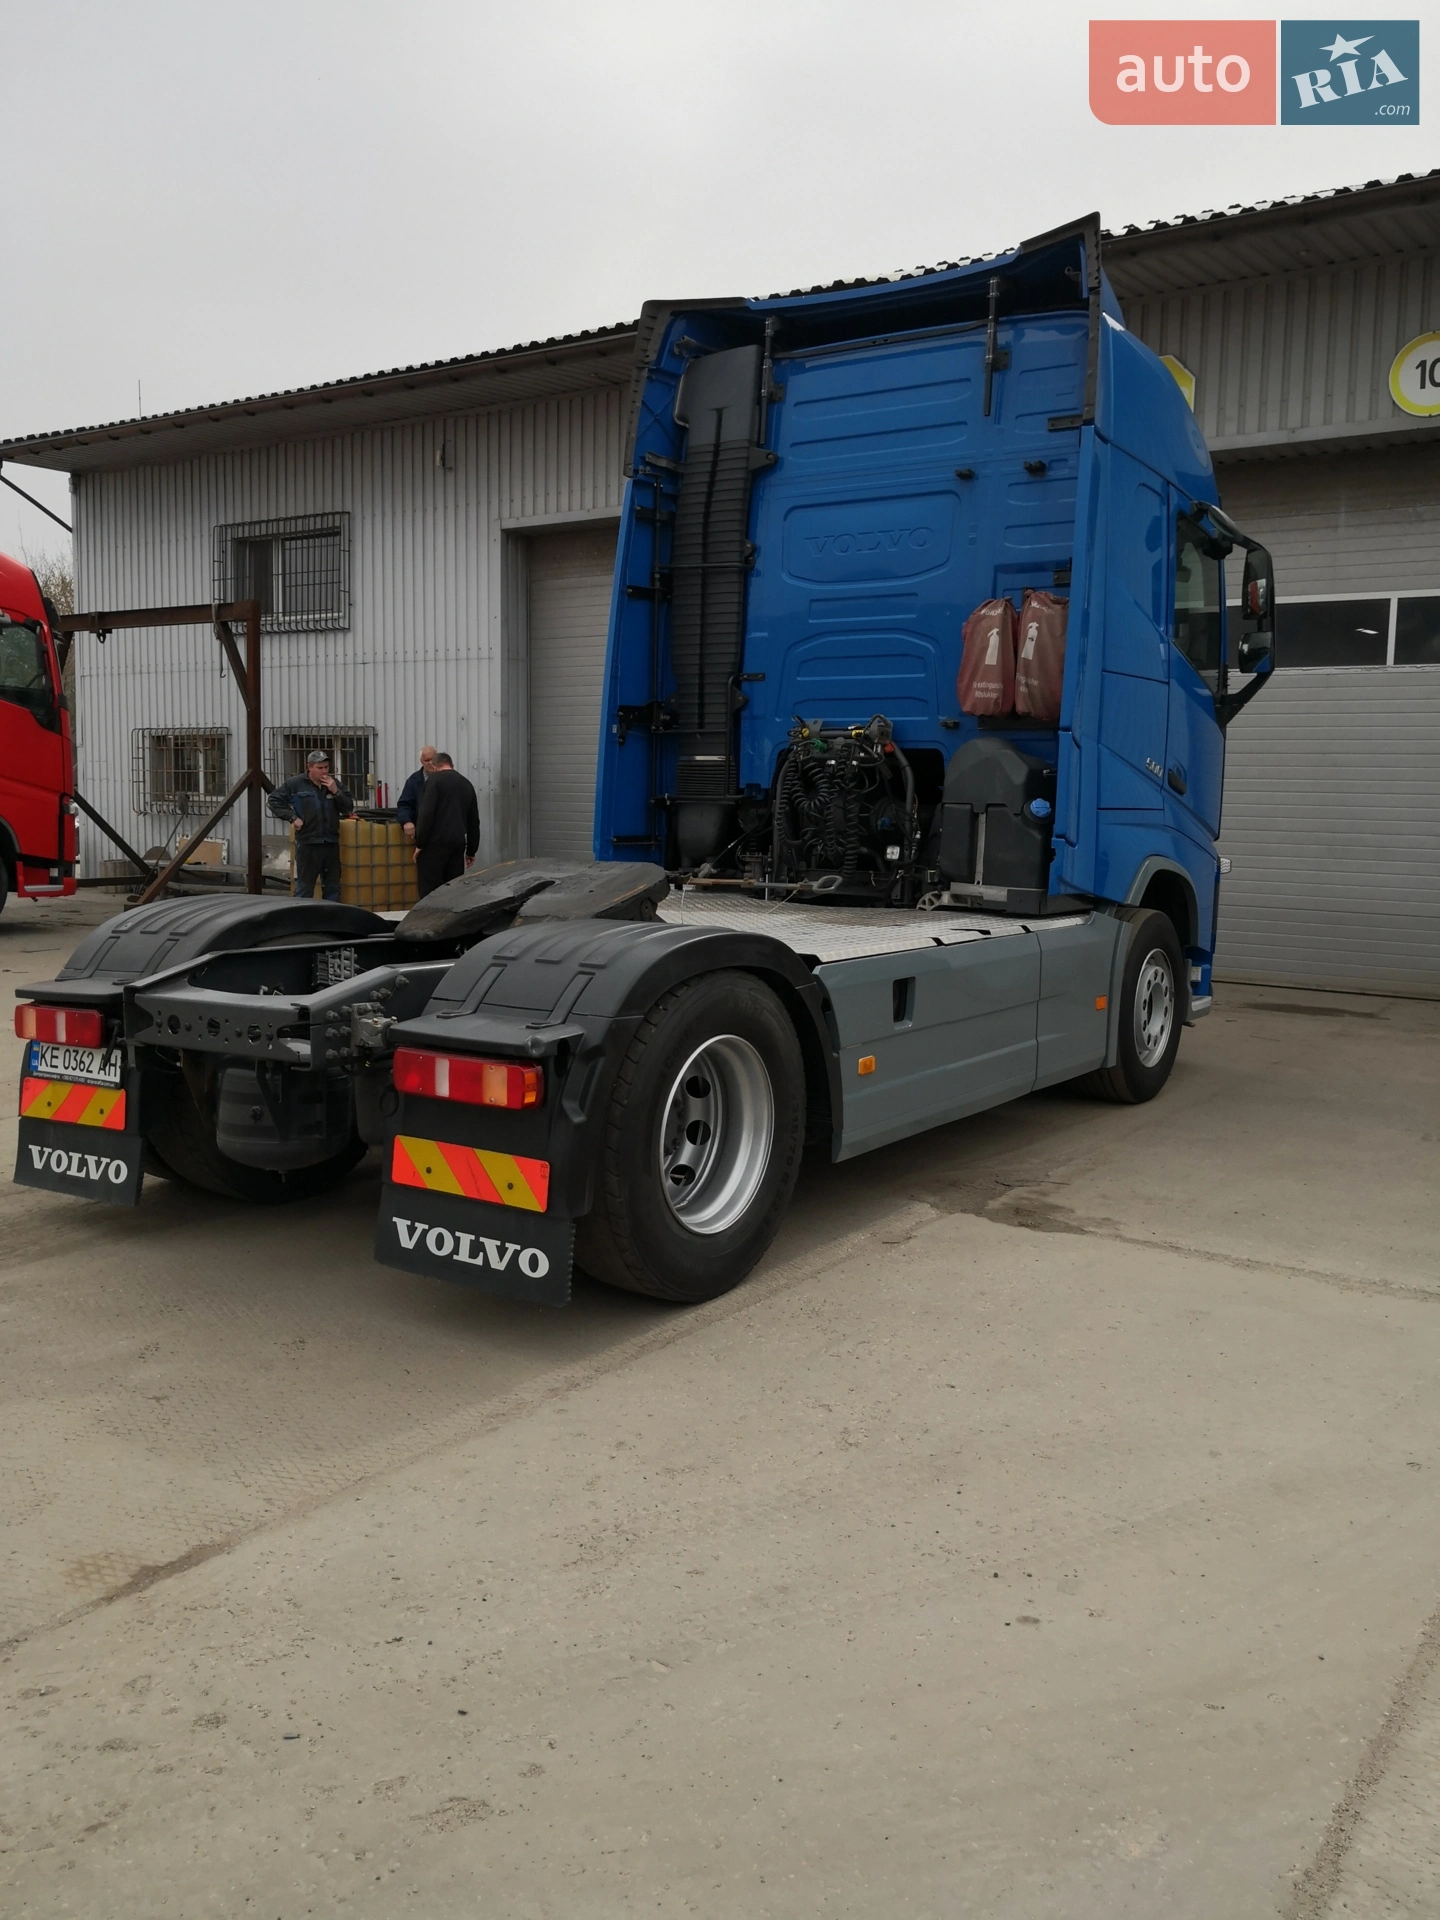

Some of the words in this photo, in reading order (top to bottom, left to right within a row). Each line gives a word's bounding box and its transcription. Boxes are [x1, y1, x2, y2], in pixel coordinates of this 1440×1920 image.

[803, 526, 935, 557] VOLVO
[39, 1045, 60, 1069] KE
[63, 1048, 94, 1074] 0362
[28, 1144, 128, 1184] VOLVO
[392, 1216, 550, 1278] VOLVO
